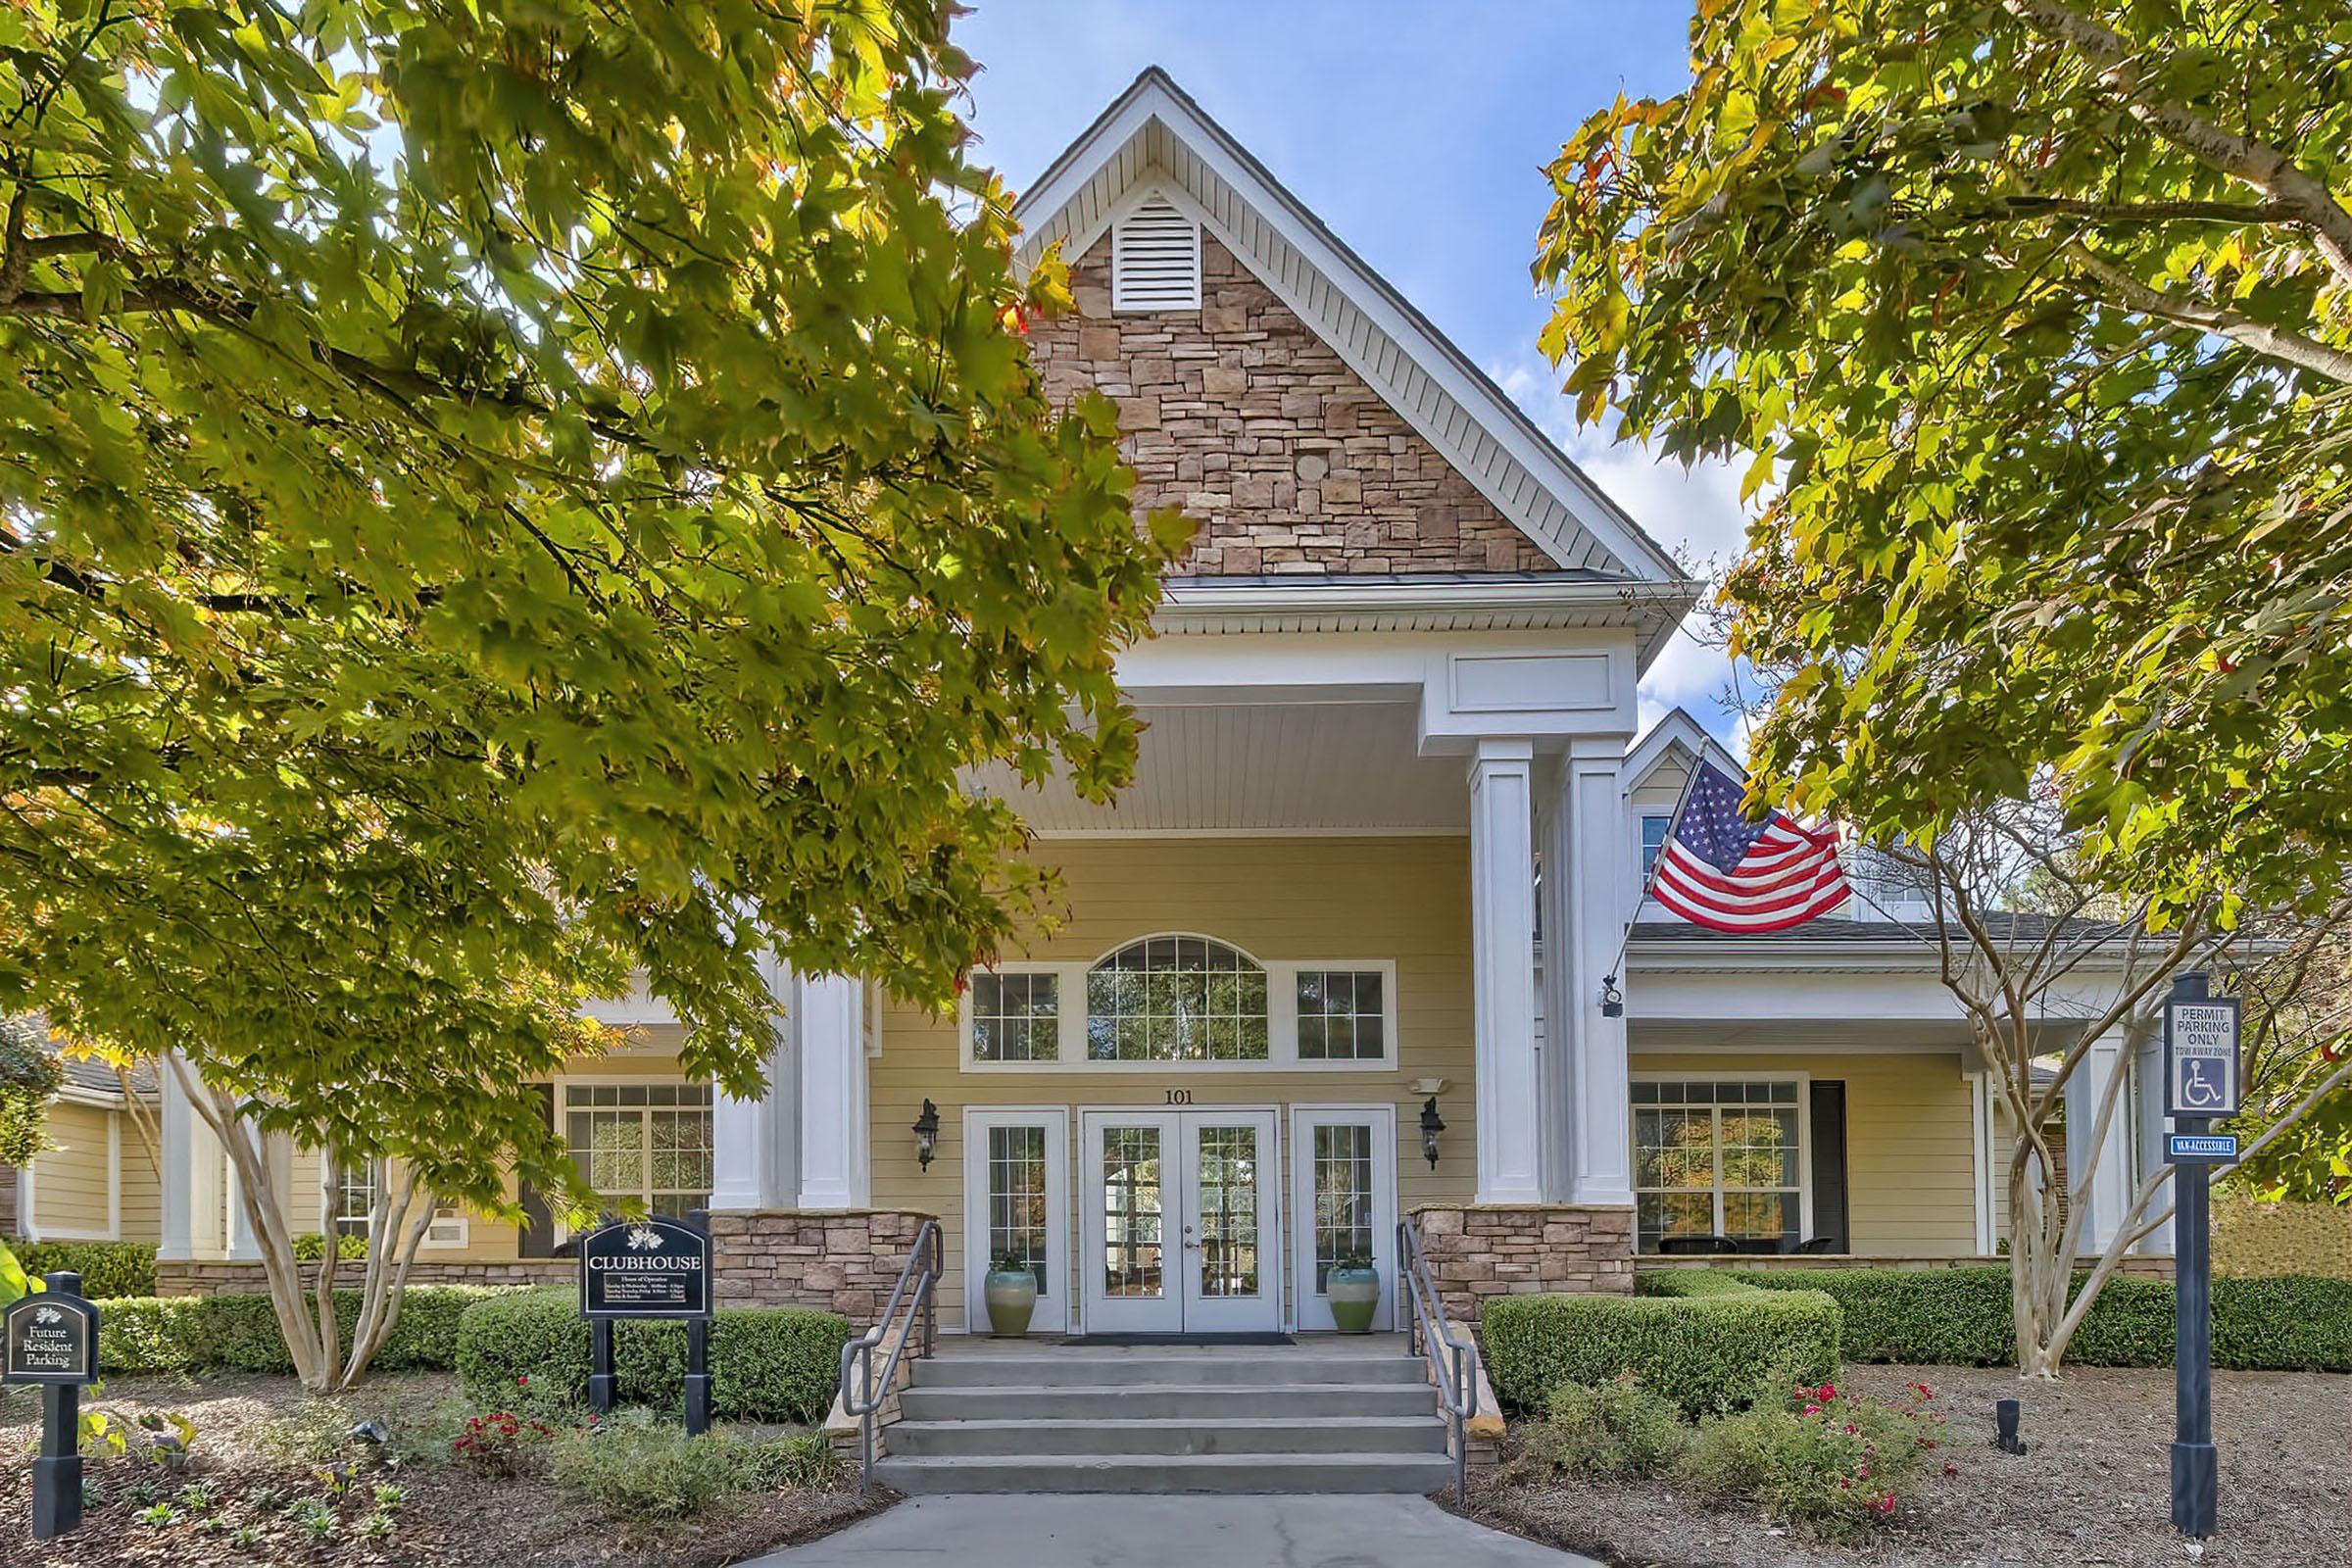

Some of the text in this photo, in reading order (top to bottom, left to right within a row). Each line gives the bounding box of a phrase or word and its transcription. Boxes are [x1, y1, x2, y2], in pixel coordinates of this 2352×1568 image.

[2181, 1008, 2226, 1020] PERMIT
[2178, 1021, 2230, 1033] PARKING
[2187, 1034, 2219, 1045] ONLY
[1165, 1089, 1194, 1105] 101
[589, 1256, 702, 1270] CLUBHOUSE
[29, 1326, 68, 1339] Future
[23, 1340, 74, 1352] Resident
[25, 1353, 71, 1369] Parking
